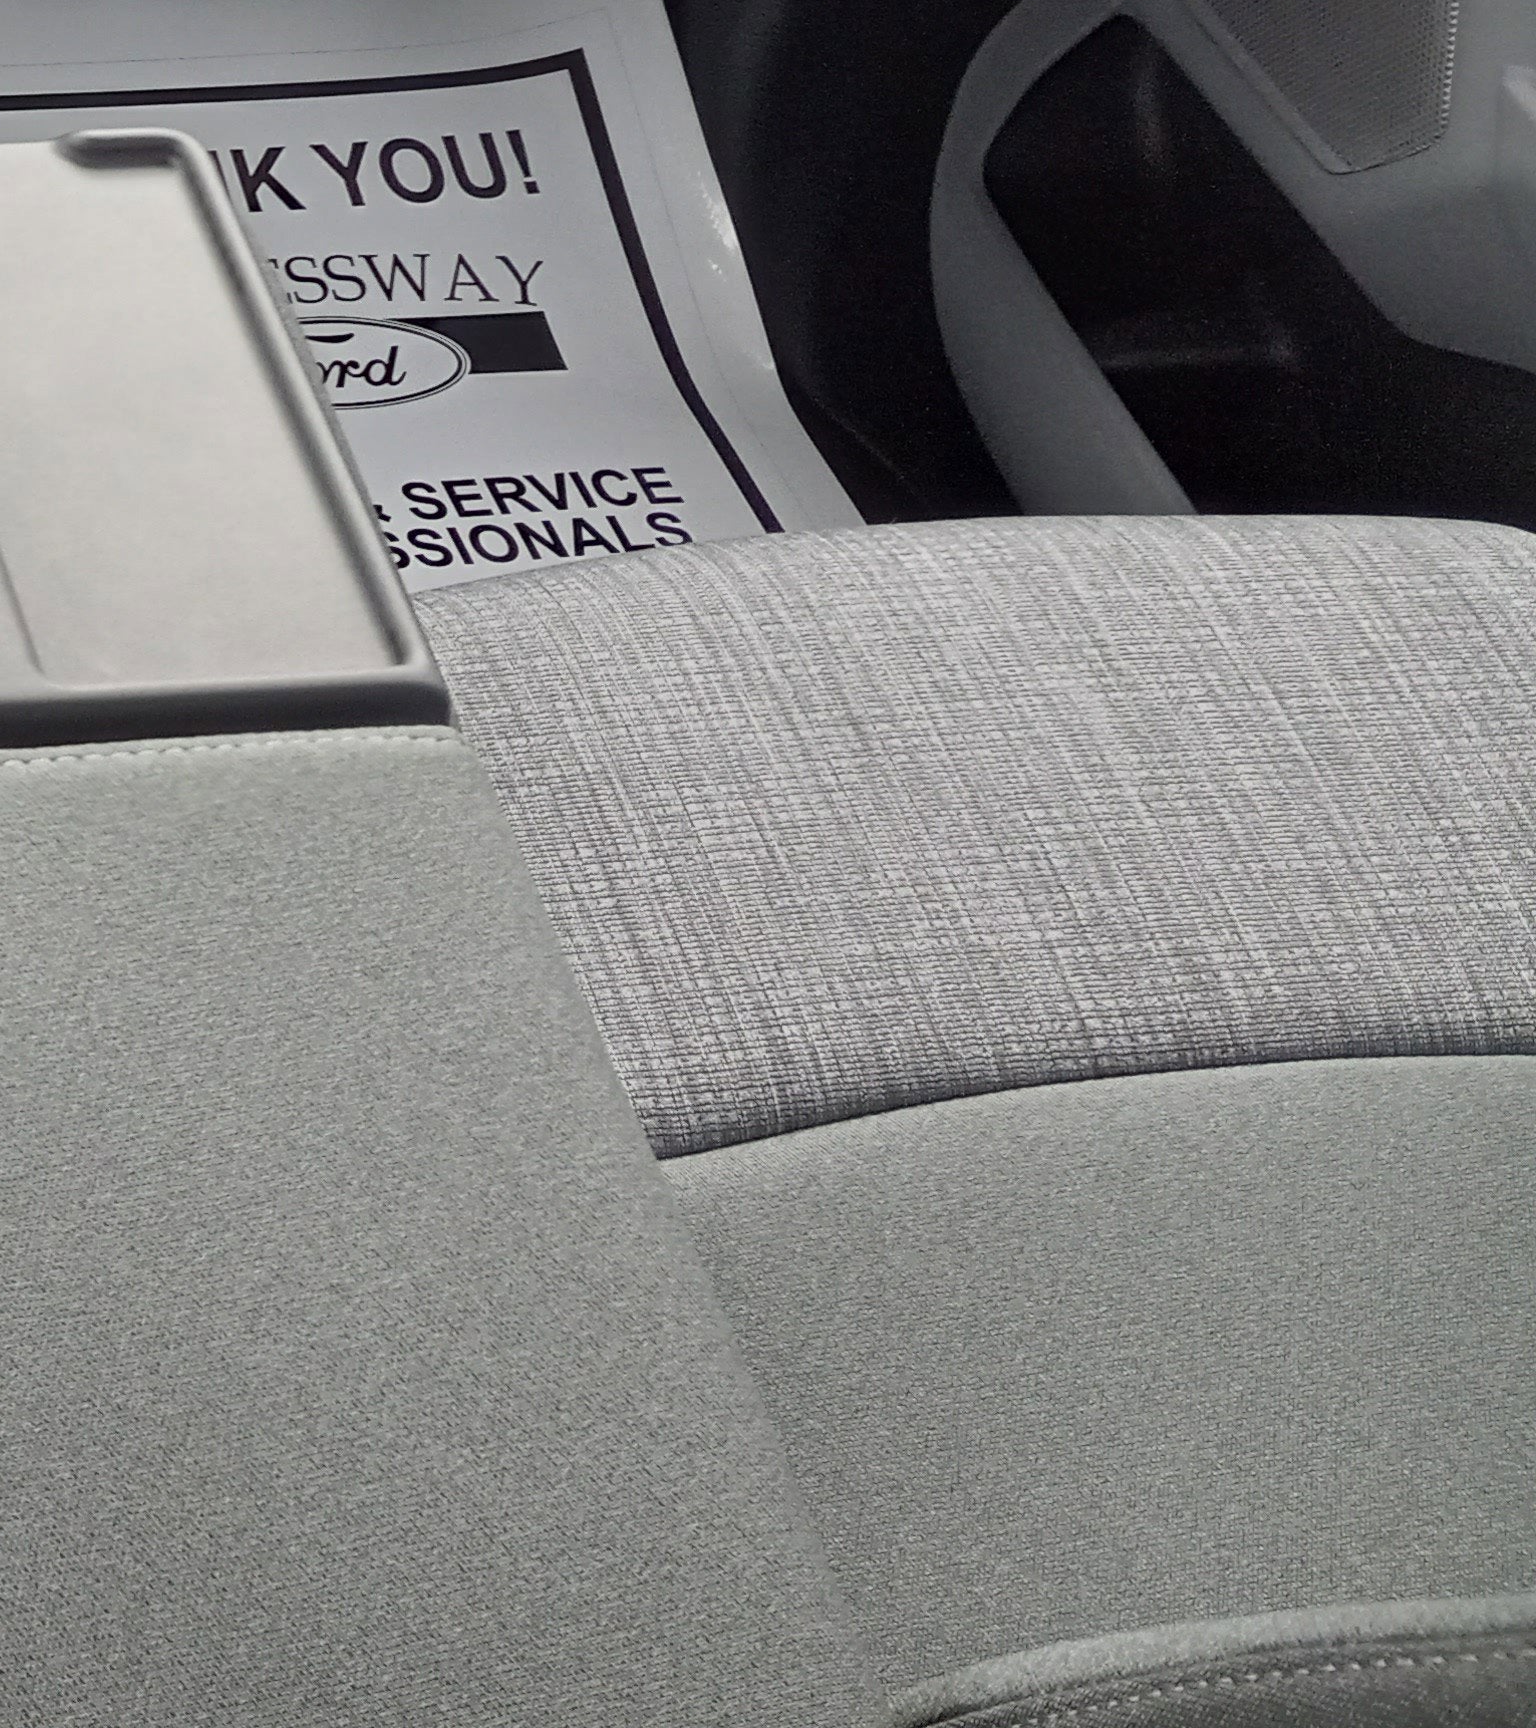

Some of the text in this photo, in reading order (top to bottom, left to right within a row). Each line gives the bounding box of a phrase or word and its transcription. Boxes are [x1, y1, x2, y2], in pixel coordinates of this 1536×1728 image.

[309, 129, 540, 207] YOU!
[268, 252, 544, 306] SSWAY
[401, 466, 685, 521] SERVICE
